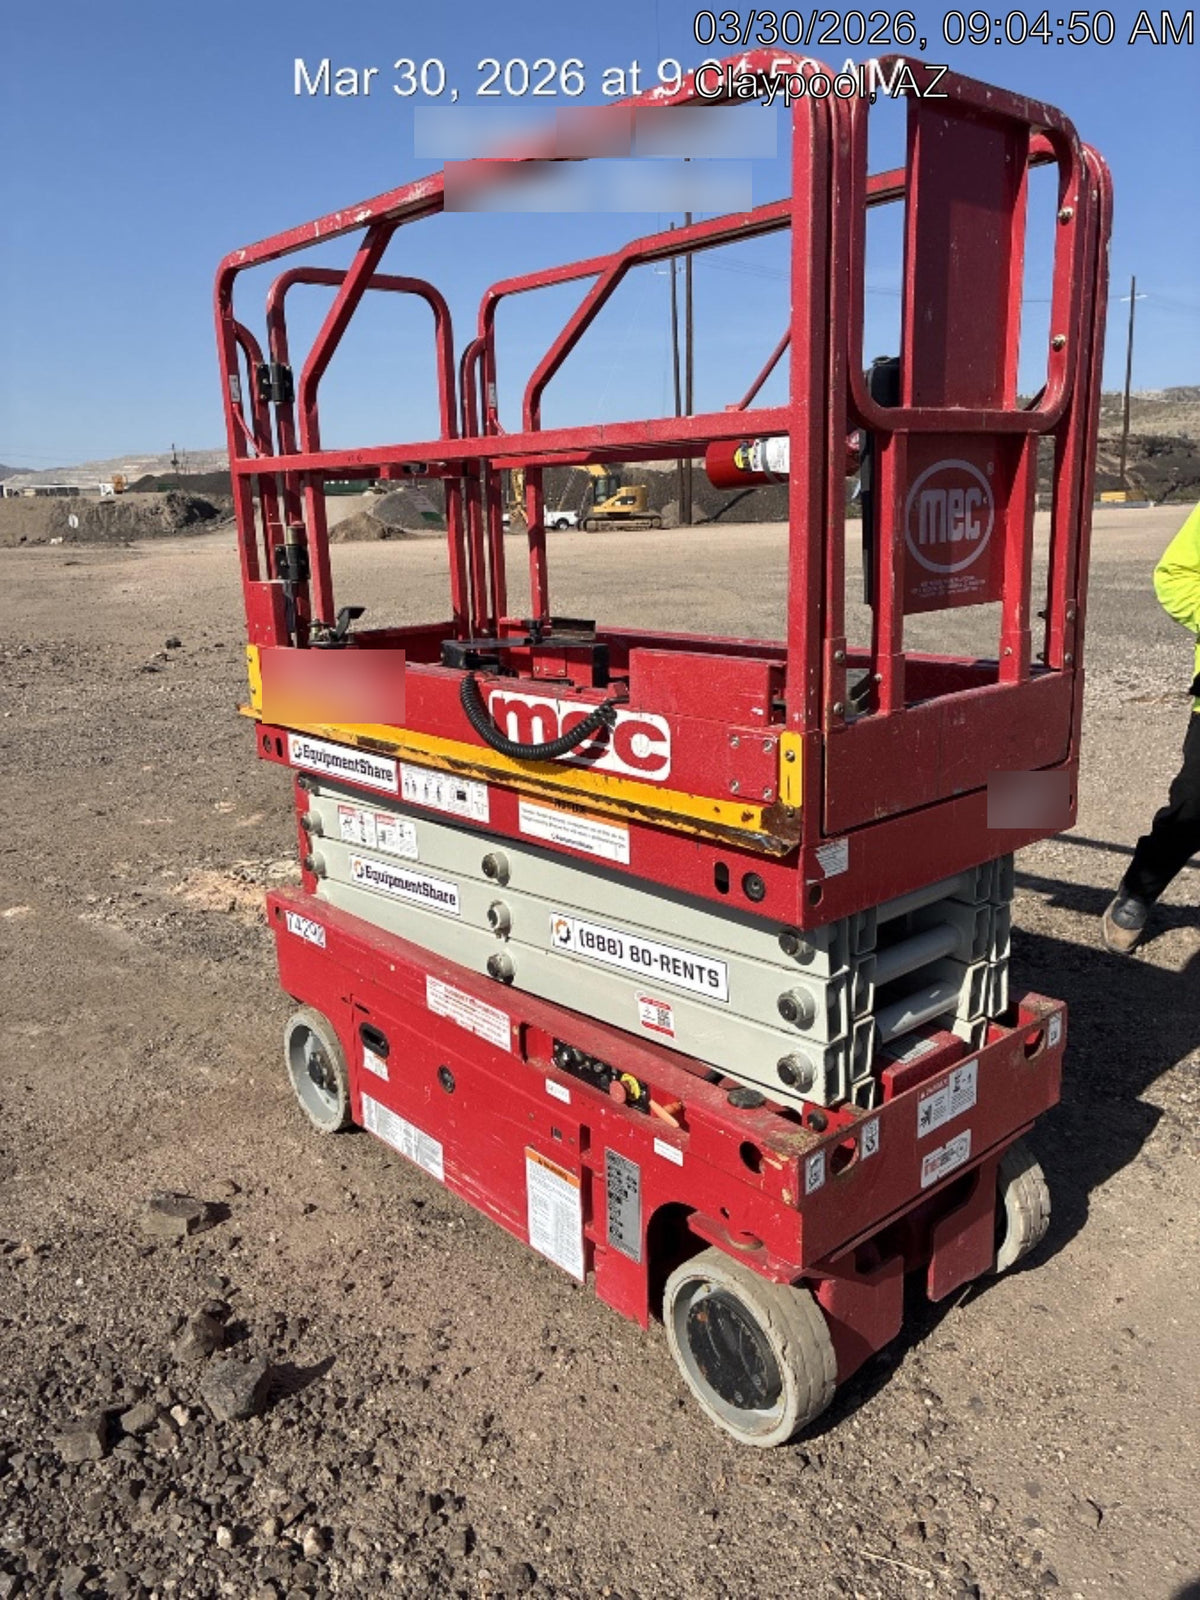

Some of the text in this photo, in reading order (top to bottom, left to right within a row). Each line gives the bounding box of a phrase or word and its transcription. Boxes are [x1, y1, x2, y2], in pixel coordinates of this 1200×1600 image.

[303, 744, 394, 782] EquipmentShare
[365, 865, 457, 906] EquipmentShare
[578, 928, 719, 988] (888) 80-RENTS
